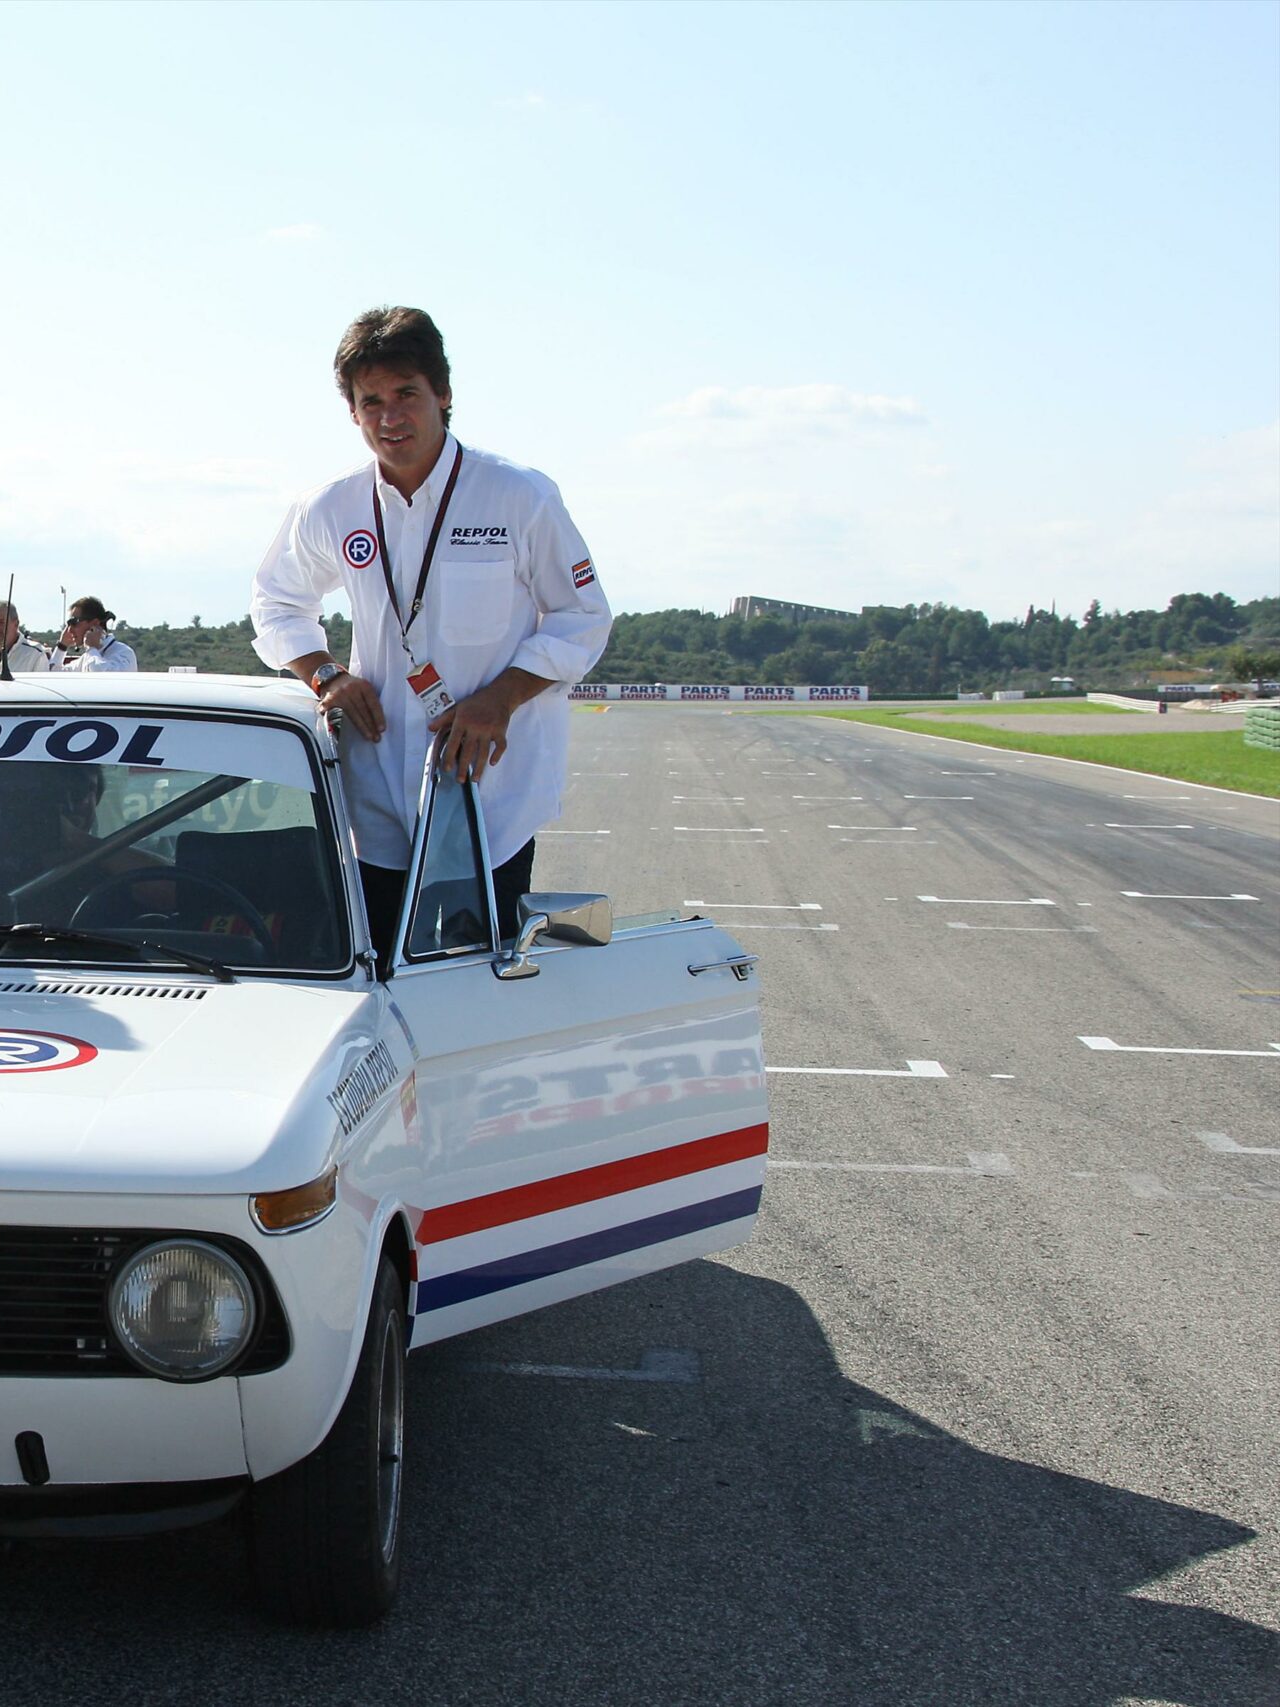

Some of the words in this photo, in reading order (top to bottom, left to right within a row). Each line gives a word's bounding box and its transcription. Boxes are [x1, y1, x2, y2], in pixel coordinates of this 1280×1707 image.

[451, 527, 508, 537] REPSOL
[571, 685, 608, 693] ARTS
[620, 685, 667, 693] PARTS
[681, 686, 730, 694] PARTS
[809, 687, 860, 695] PARTS
